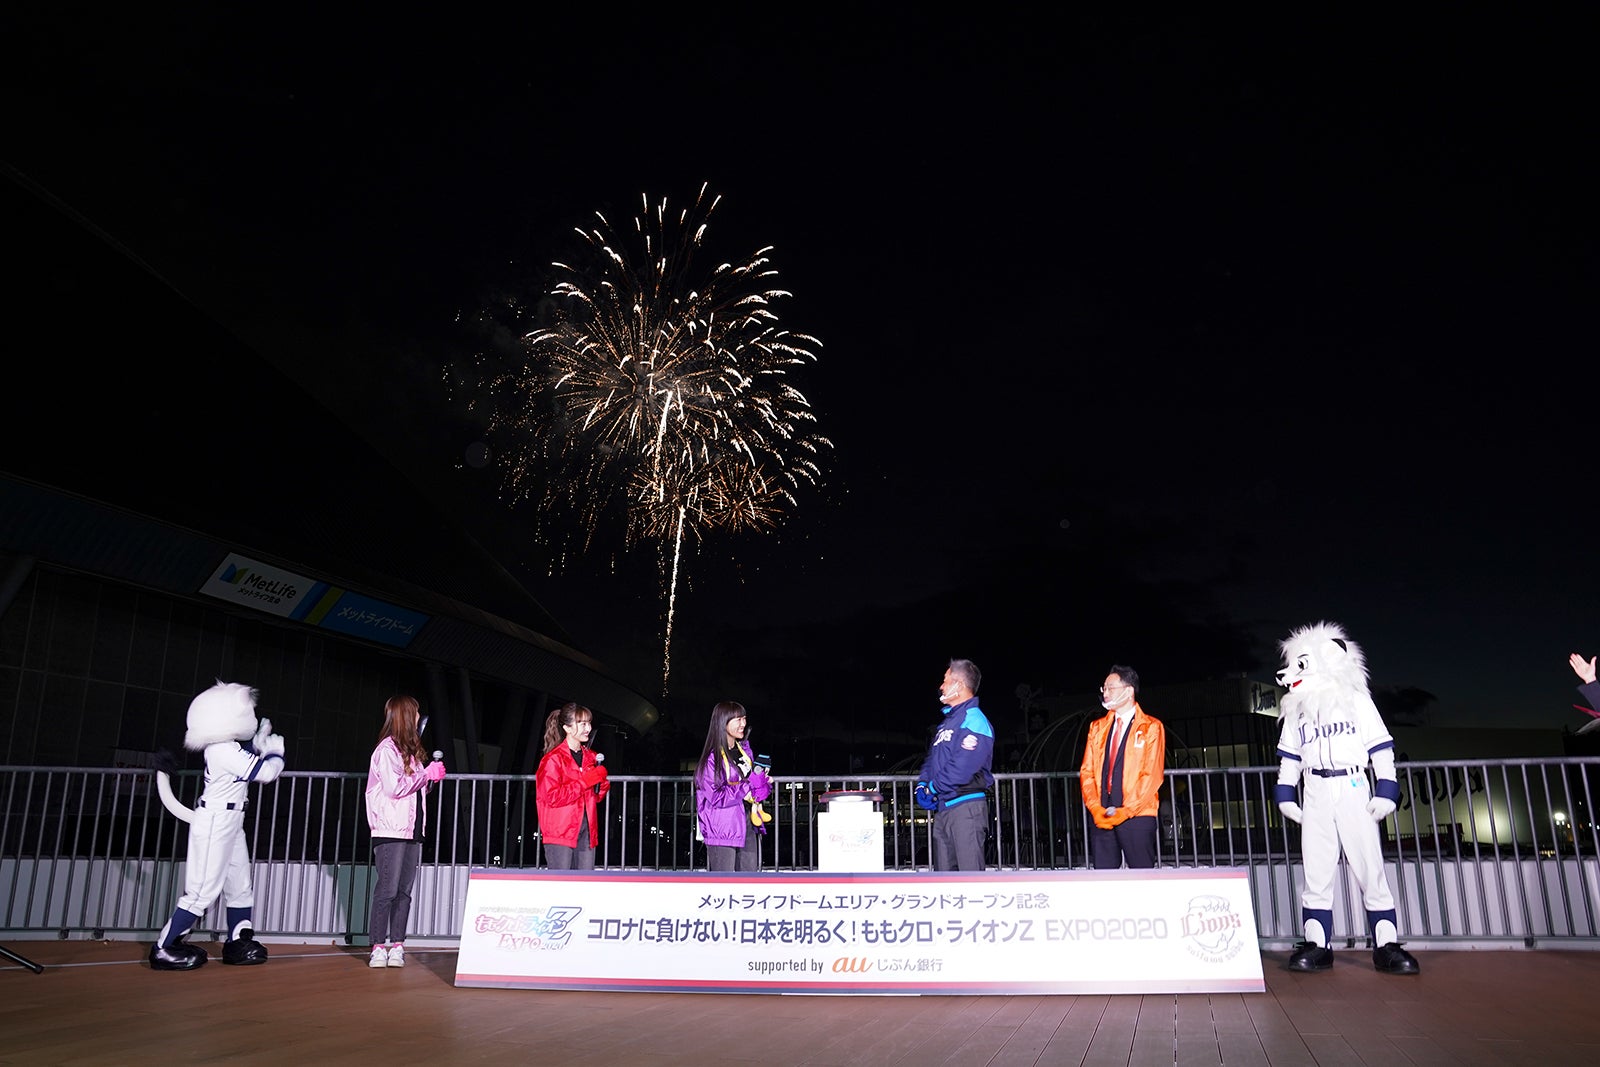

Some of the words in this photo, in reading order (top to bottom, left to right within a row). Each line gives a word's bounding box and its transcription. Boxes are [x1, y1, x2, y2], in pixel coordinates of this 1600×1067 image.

[244, 573, 297, 599] MetLife
[337, 606, 415, 636] メットライフドーム
[1298, 720, 1356, 748] Lions
[698, 893, 1050, 911] メットライフドームエリア・グランドオープン記念
[1045, 917, 1168, 942] EXPO2020
[1180, 912, 1242, 938] Lions
[748, 959, 806, 975] supported
[811, 959, 824, 975] by
[832, 957, 873, 973] au
[877, 957, 944, 973] じぶん銀行
